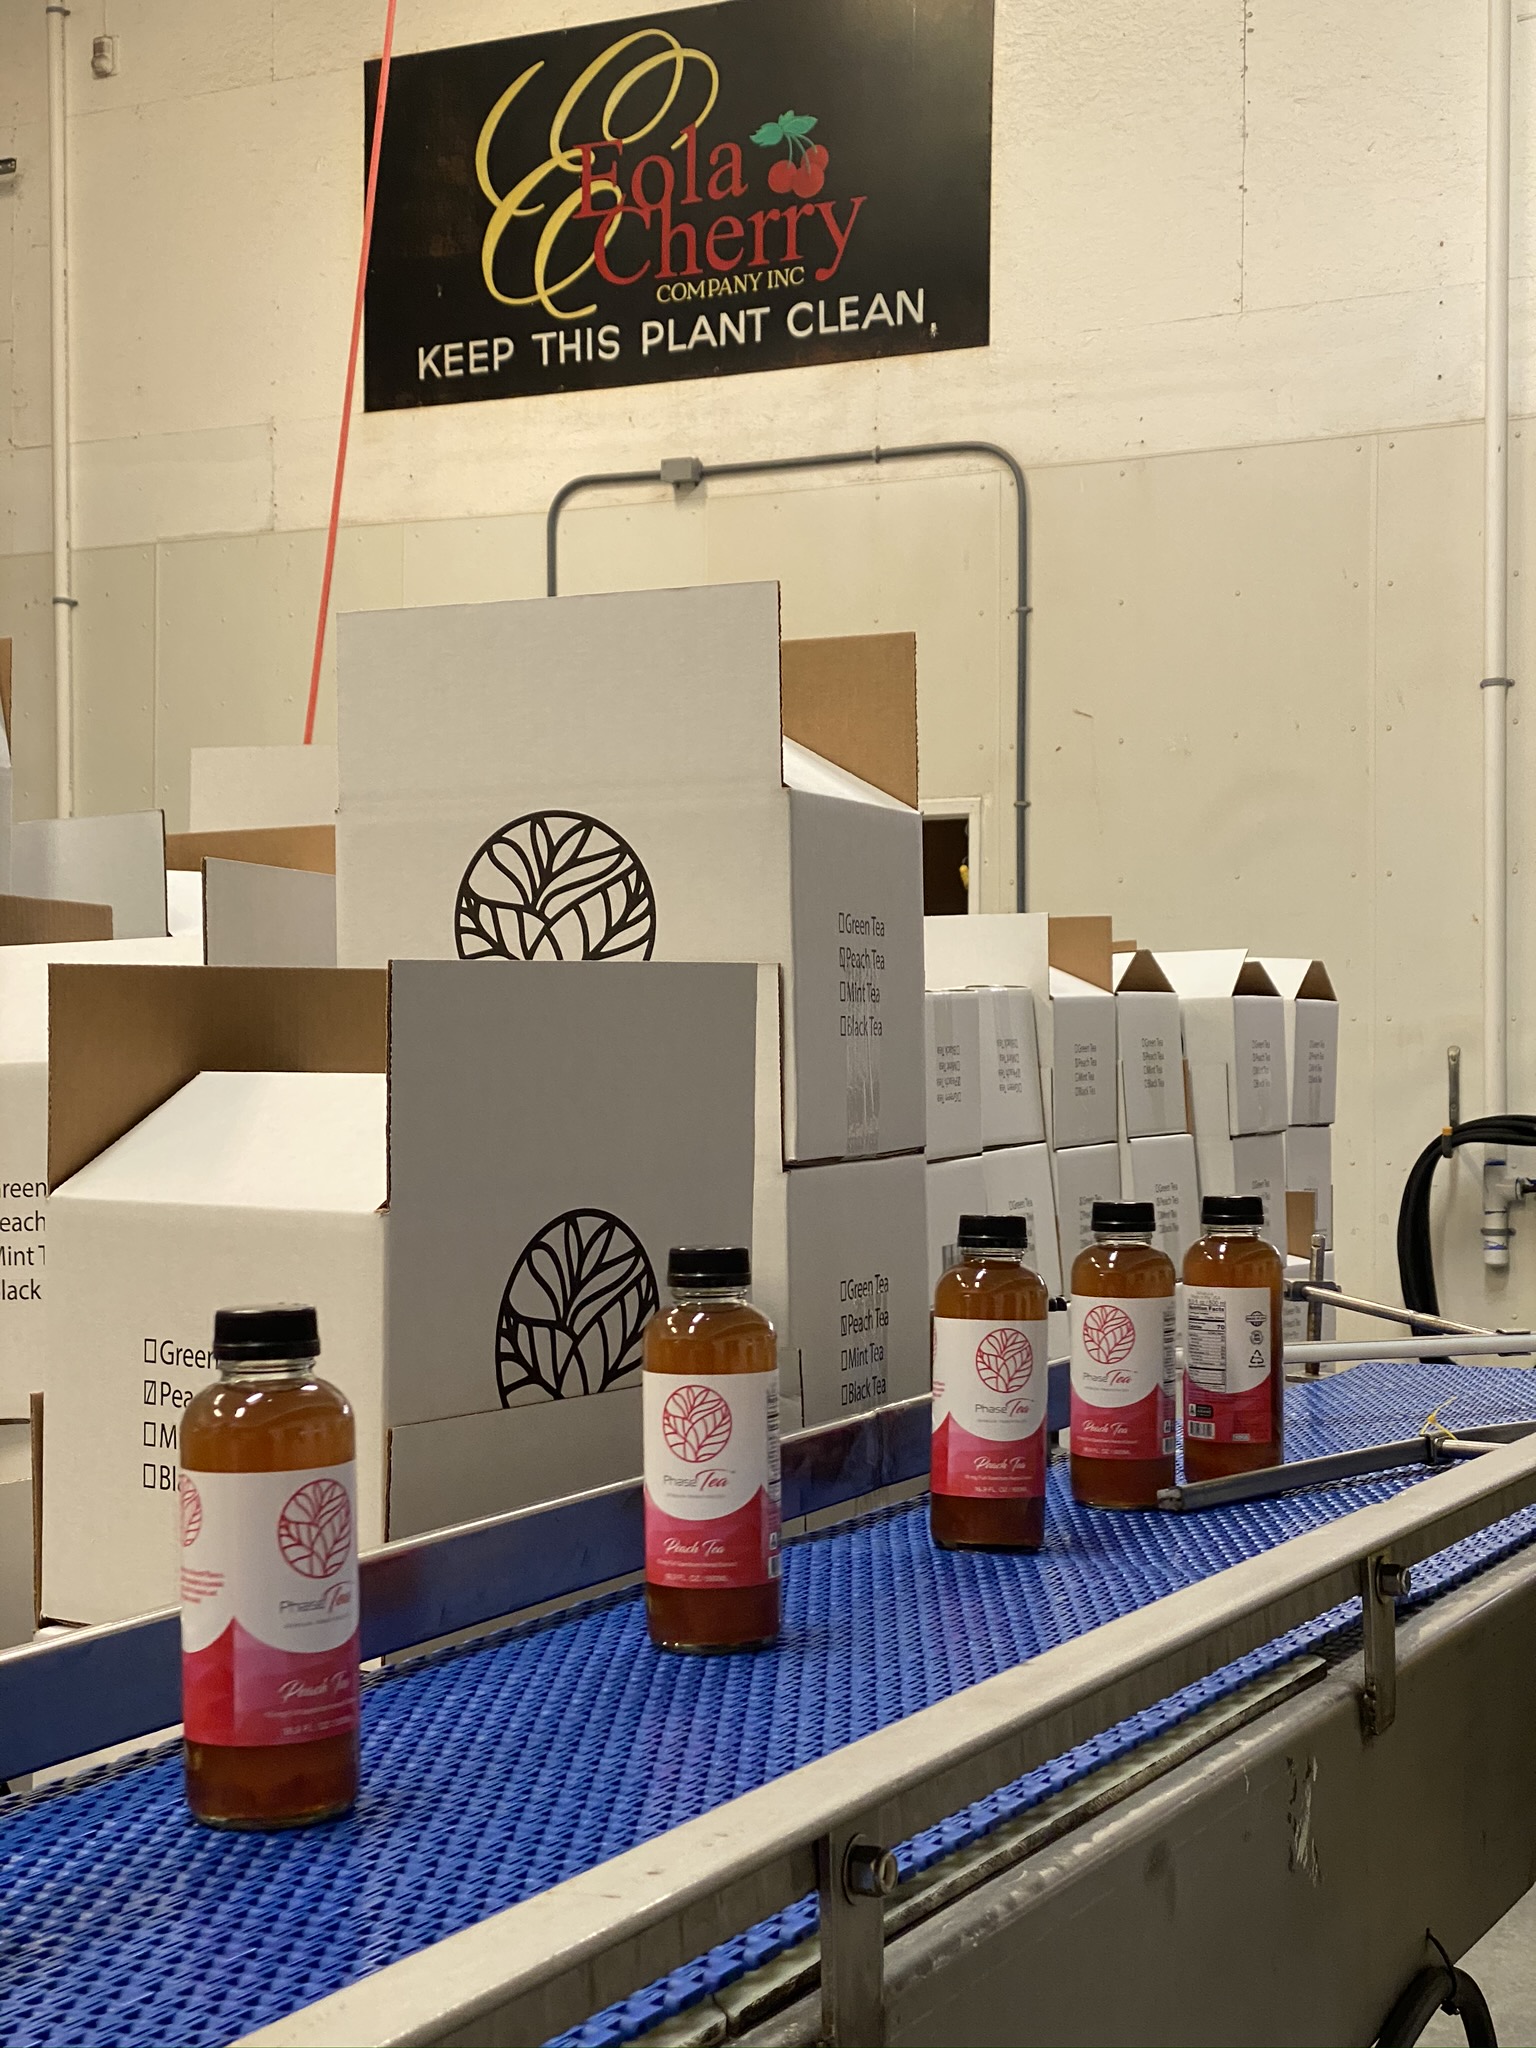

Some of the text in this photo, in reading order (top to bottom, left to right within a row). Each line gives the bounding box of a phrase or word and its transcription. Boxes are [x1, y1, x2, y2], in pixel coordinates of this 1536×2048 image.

[572, 122, 749, 219] Eola
[594, 194, 868, 286] Cherry
[656, 266, 805, 303] COMPANY INC
[417, 336, 515, 381] KEEP
[532, 325, 621, 366] THIS
[641, 307, 771, 355] PLANT
[845, 913, 885, 937] Green Tea
[846, 947, 885, 970] Peach Tea
[847, 981, 880, 1003] Mint Tea
[847, 1015, 882, 1037] Black Tea
[0, 1182, 47, 1199] reen
[0, 1210, 46, 1232] each
[0, 1278, 42, 1301] lack
[847, 1274, 889, 1300] Green Tea
[847, 1308, 889, 1335] Peach Tea
[848, 1343, 884, 1369] Mint Tea
[160, 1381, 194, 1408] Pea
[848, 1376, 886, 1404] Black Tea
[663, 1537, 726, 1557] Peach Tea
